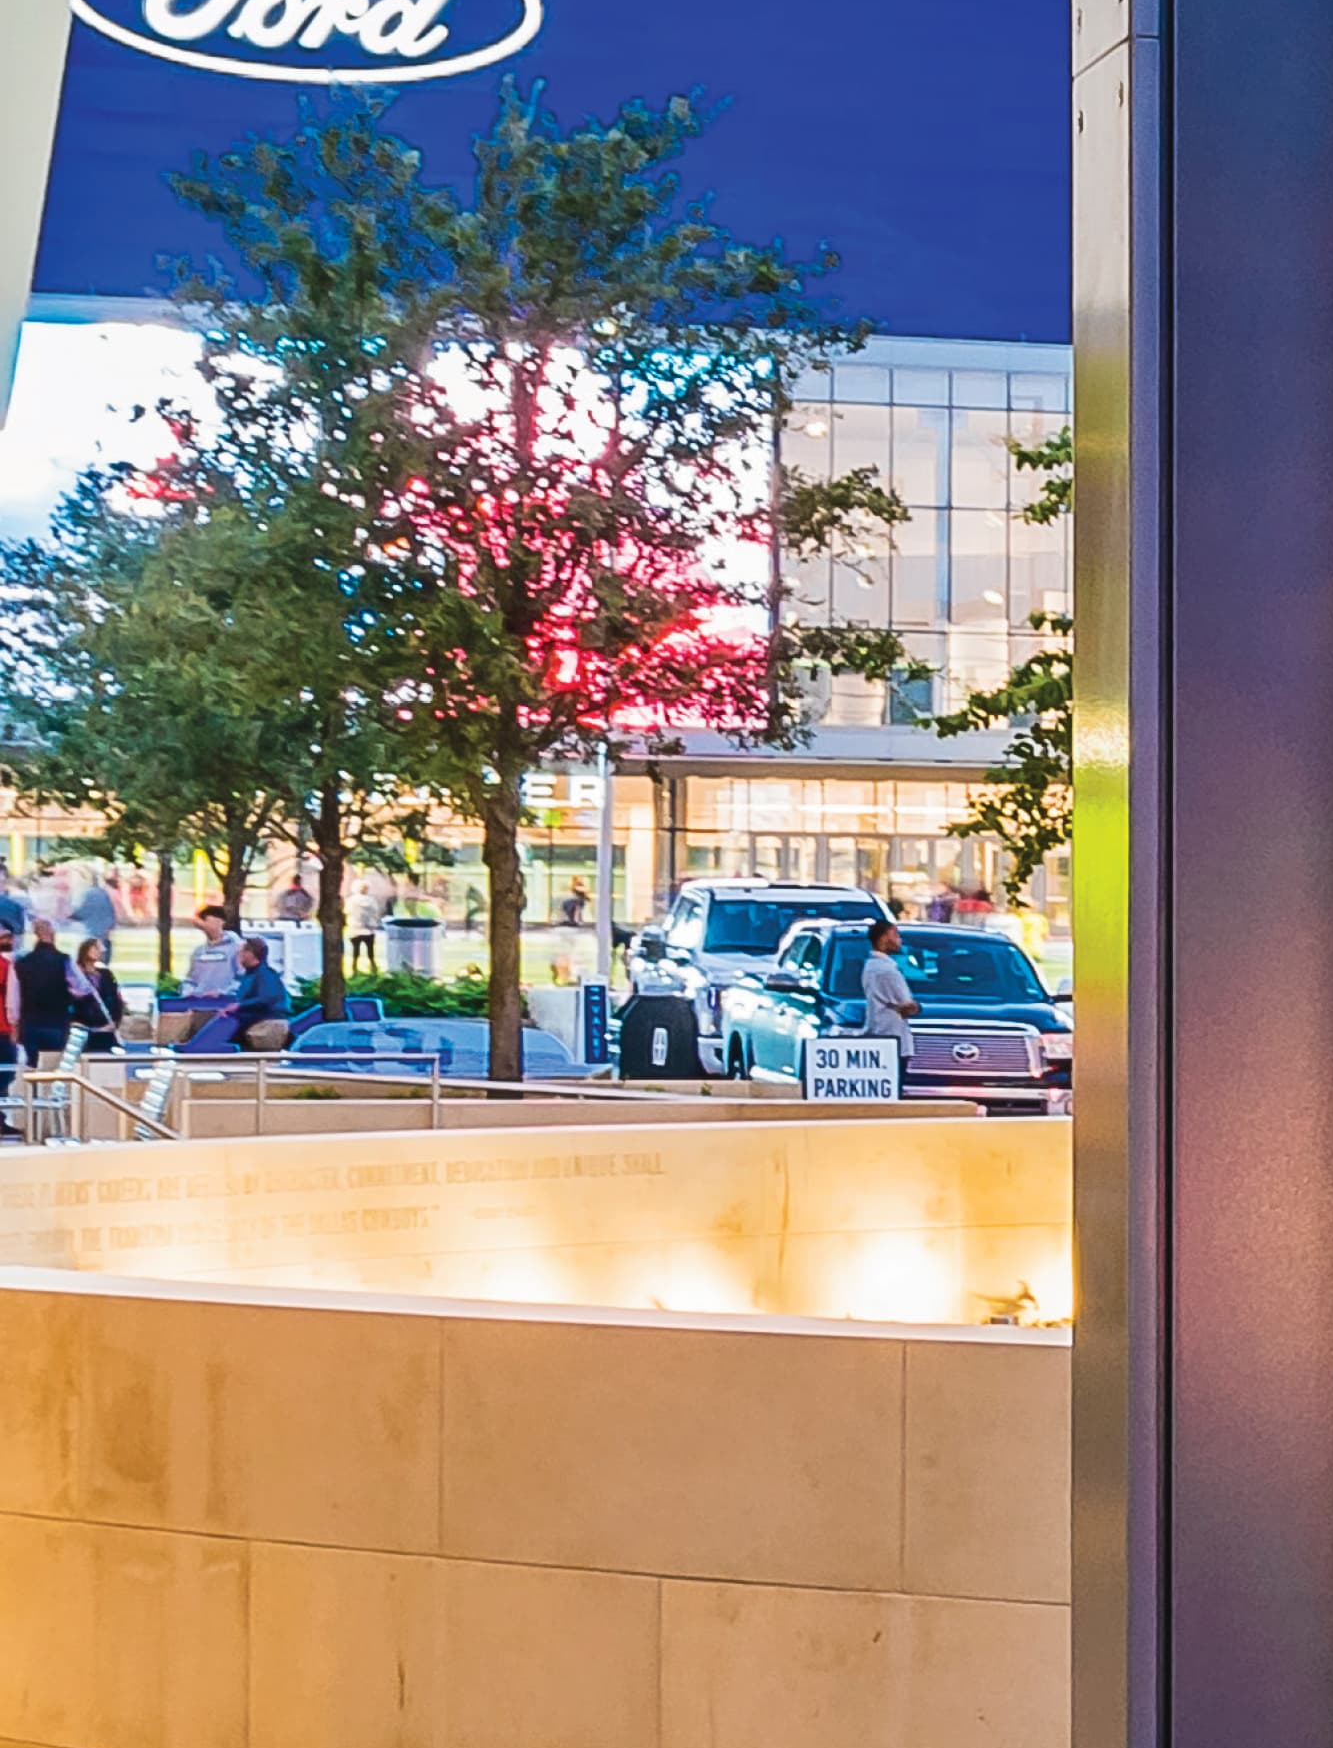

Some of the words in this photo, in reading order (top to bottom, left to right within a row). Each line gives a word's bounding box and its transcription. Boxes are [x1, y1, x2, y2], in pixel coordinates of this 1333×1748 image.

[816, 1049, 839, 1069] 30
[846, 1049, 887, 1069] MIN.
[814, 1078, 891, 1099] PARKING
